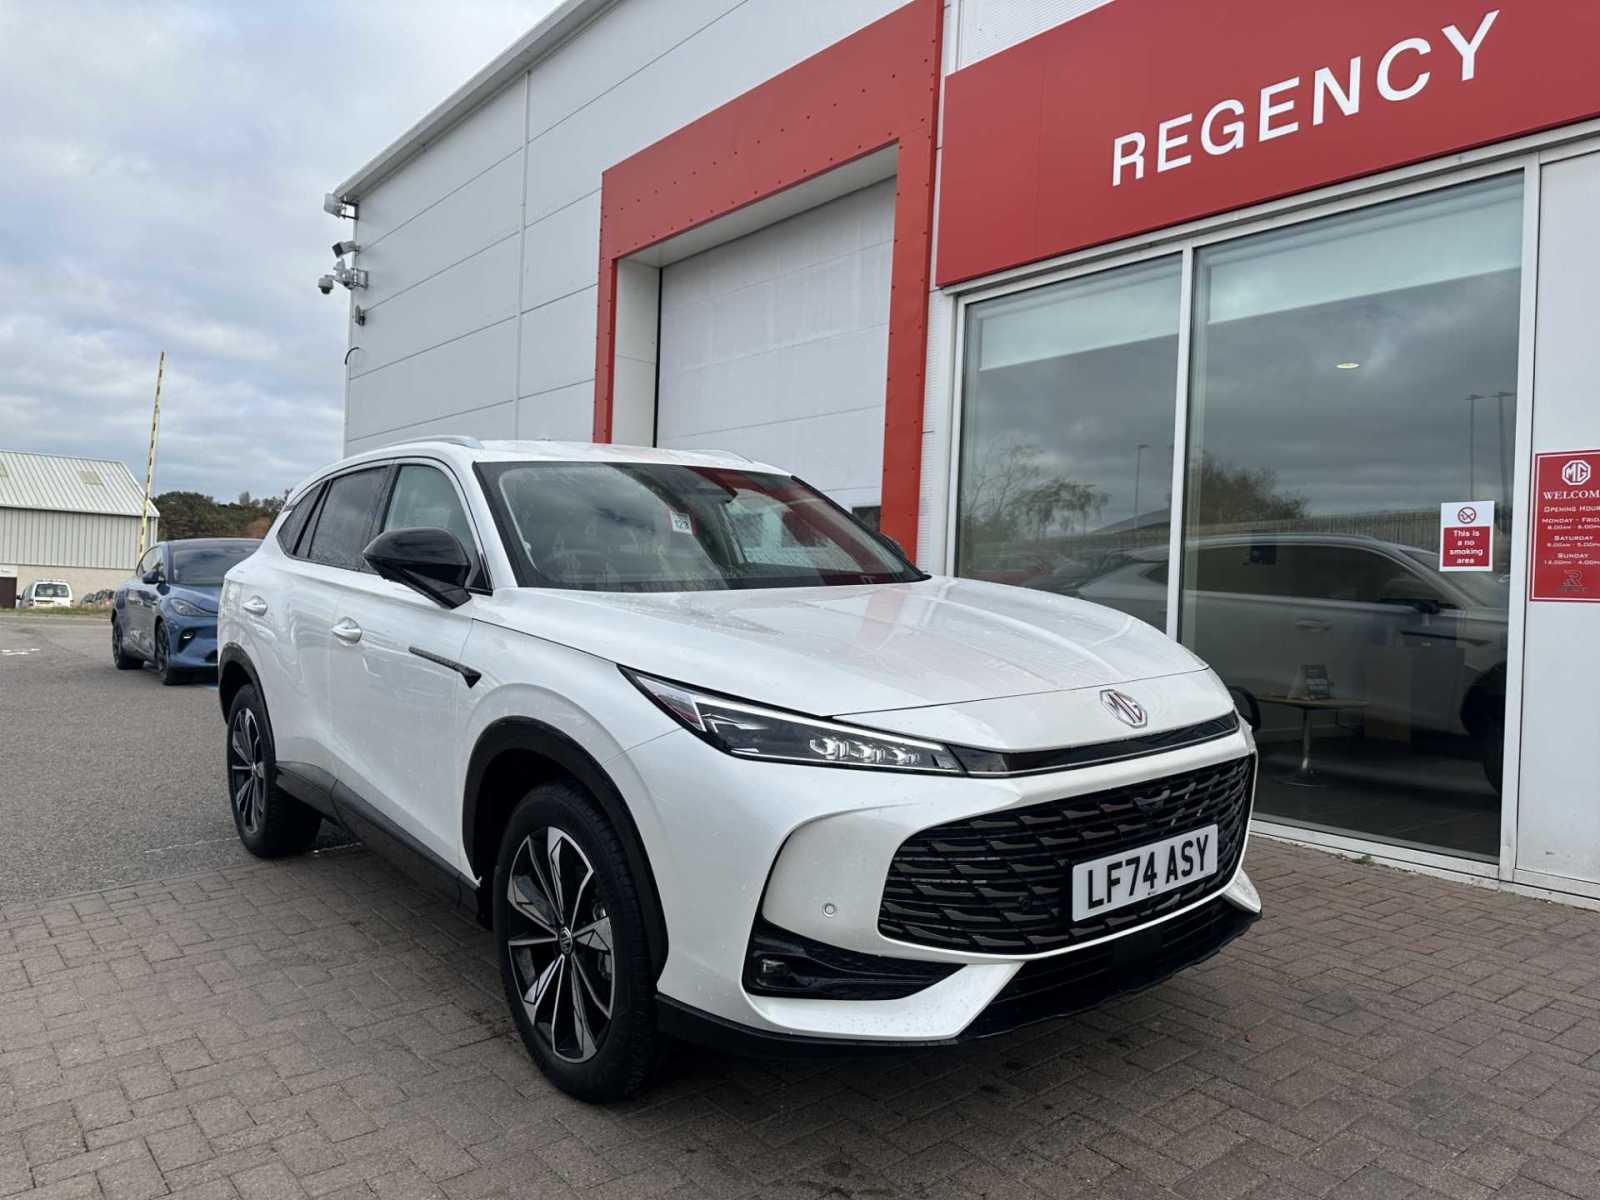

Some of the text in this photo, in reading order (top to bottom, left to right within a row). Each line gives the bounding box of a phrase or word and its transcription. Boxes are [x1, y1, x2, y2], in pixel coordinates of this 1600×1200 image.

[1112, 10, 1500, 186] REGENCY
[1564, 461, 1590, 484] MG
[1449, 548, 1483, 557] smoking
[1088, 834, 1208, 910] LF74 ASY
